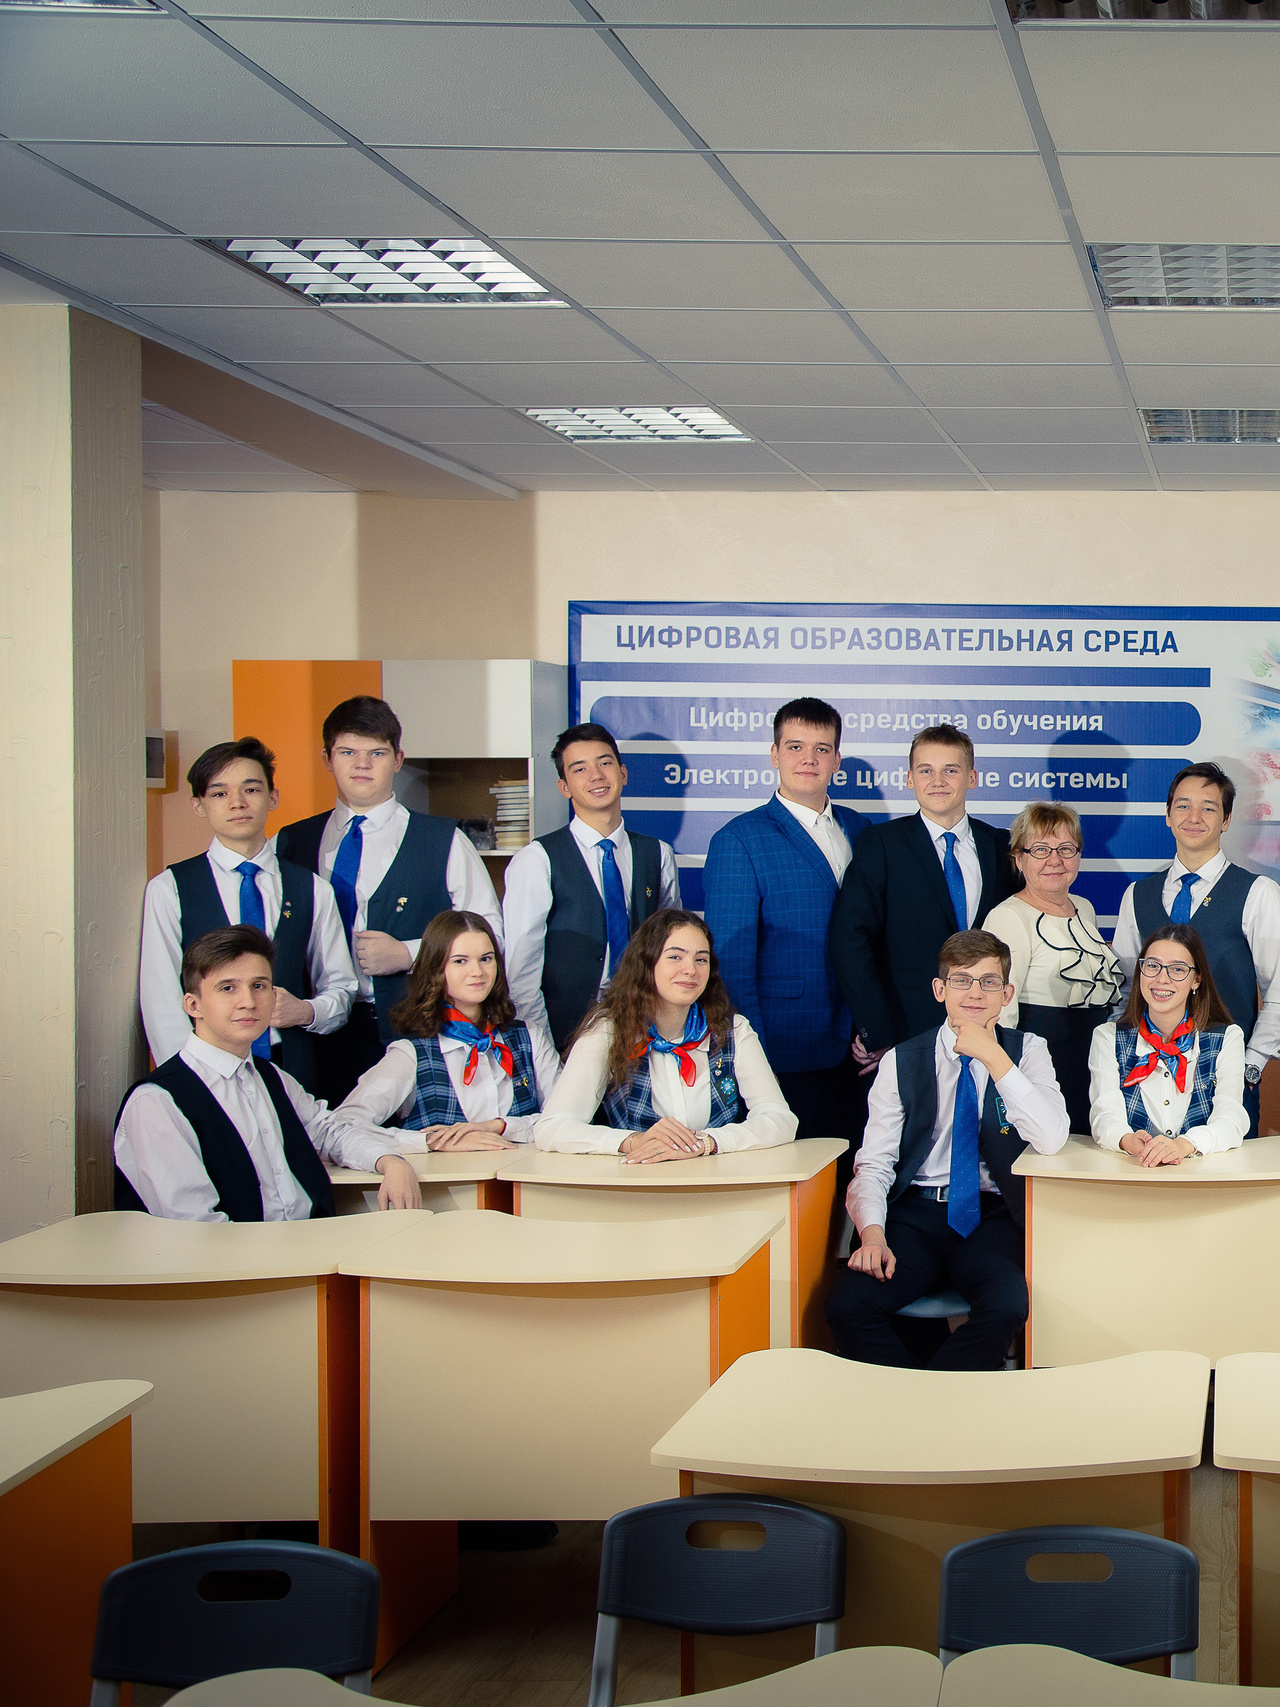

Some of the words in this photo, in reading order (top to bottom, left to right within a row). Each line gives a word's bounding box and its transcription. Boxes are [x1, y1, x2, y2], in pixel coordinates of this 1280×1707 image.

[617, 625, 780, 651] ЦИФРОВАЯ
[790, 626, 1073, 652] ОБРАЗОВАТЕЛЬНАЯ
[1083, 629, 1179, 656] СРЕДА
[690, 707, 776, 732] Цифро
[845, 711, 968, 733] средства
[977, 710, 1103, 735] обучения
[664, 764, 847, 789] Электрое
[1009, 770, 1128, 789] системы
